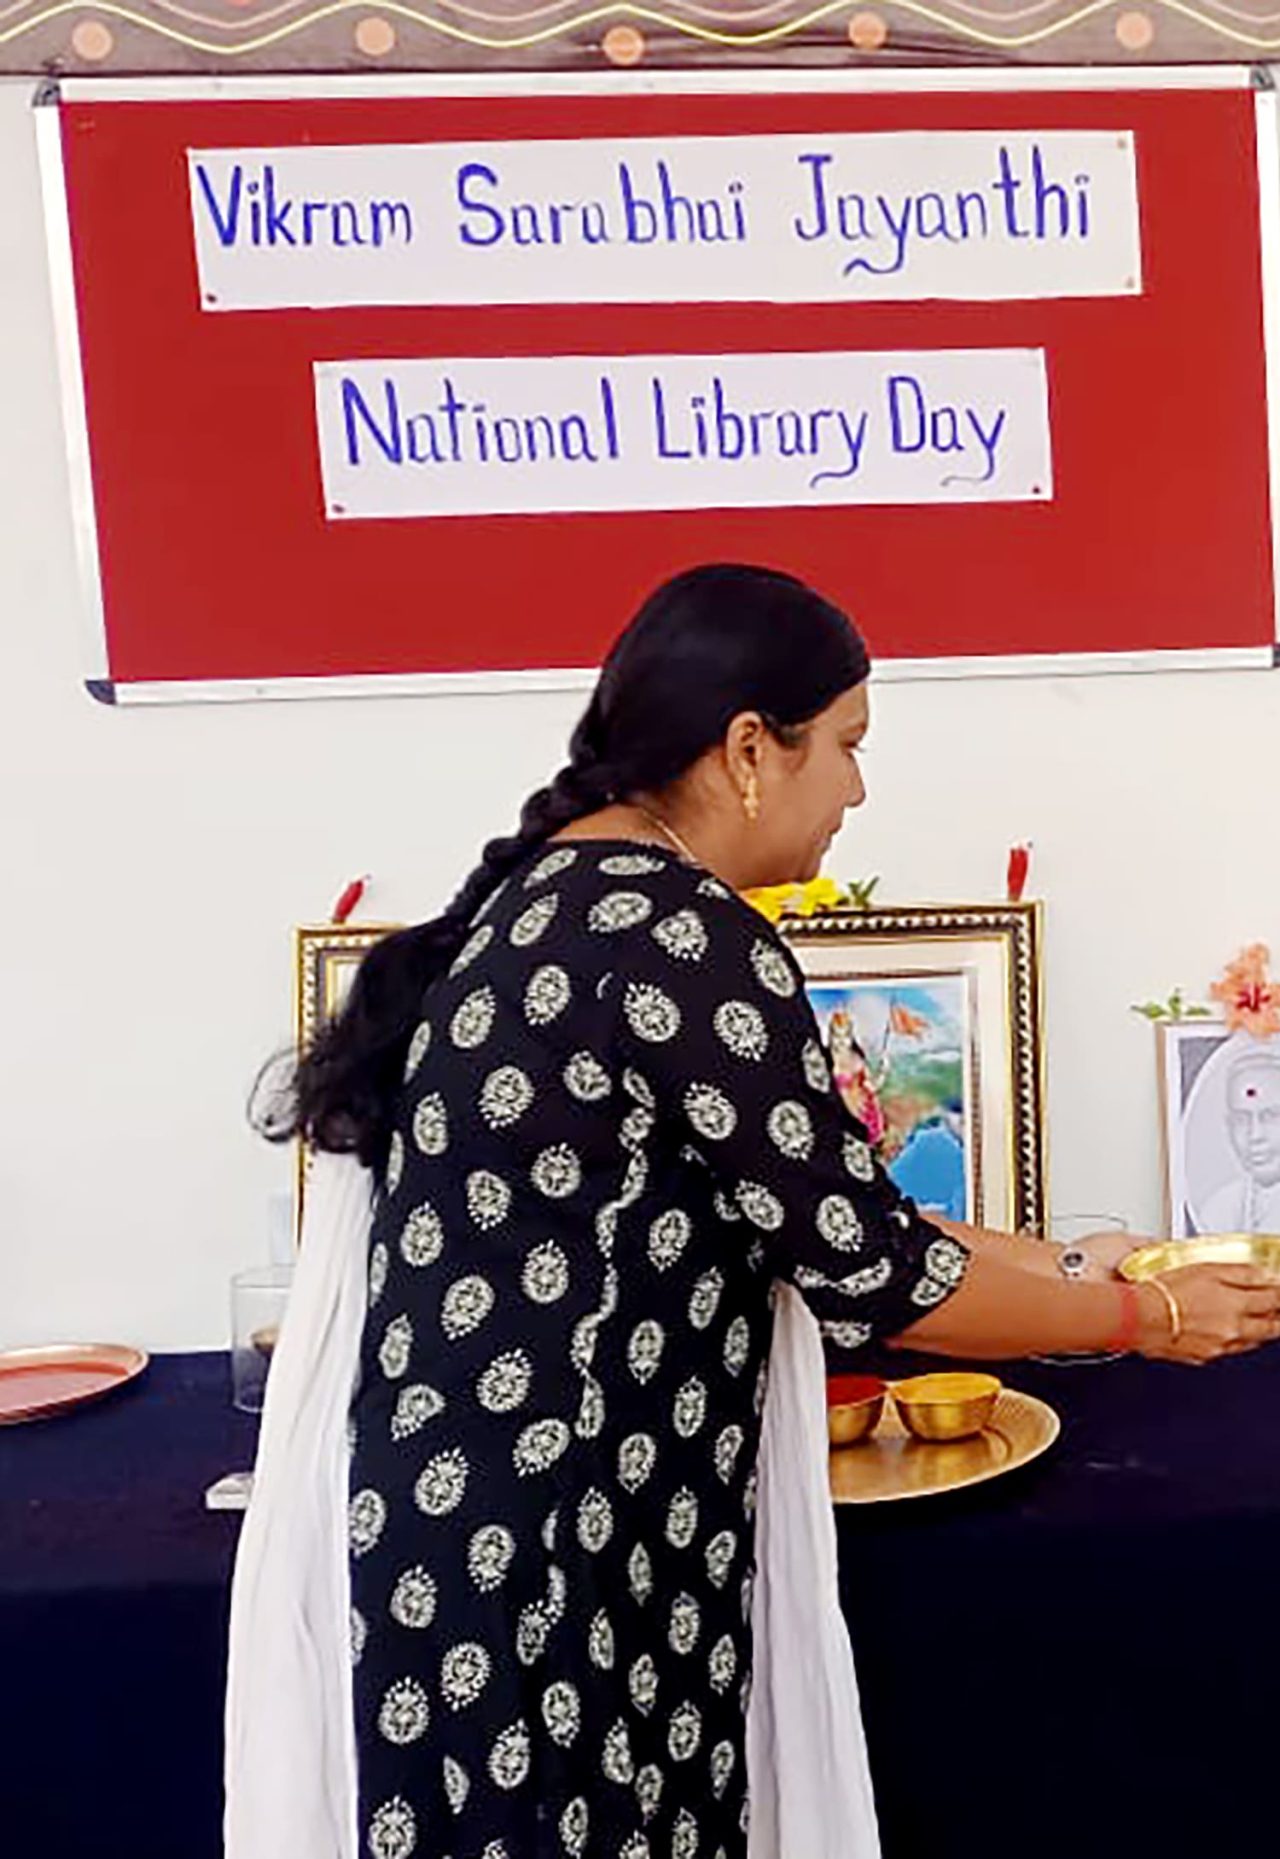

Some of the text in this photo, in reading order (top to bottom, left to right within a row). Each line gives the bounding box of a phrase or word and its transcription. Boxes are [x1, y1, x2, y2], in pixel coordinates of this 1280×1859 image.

[196, 146, 1091, 277] Vikram Sarabhai Jayanthi
[342, 376, 1005, 488] National Library Day
